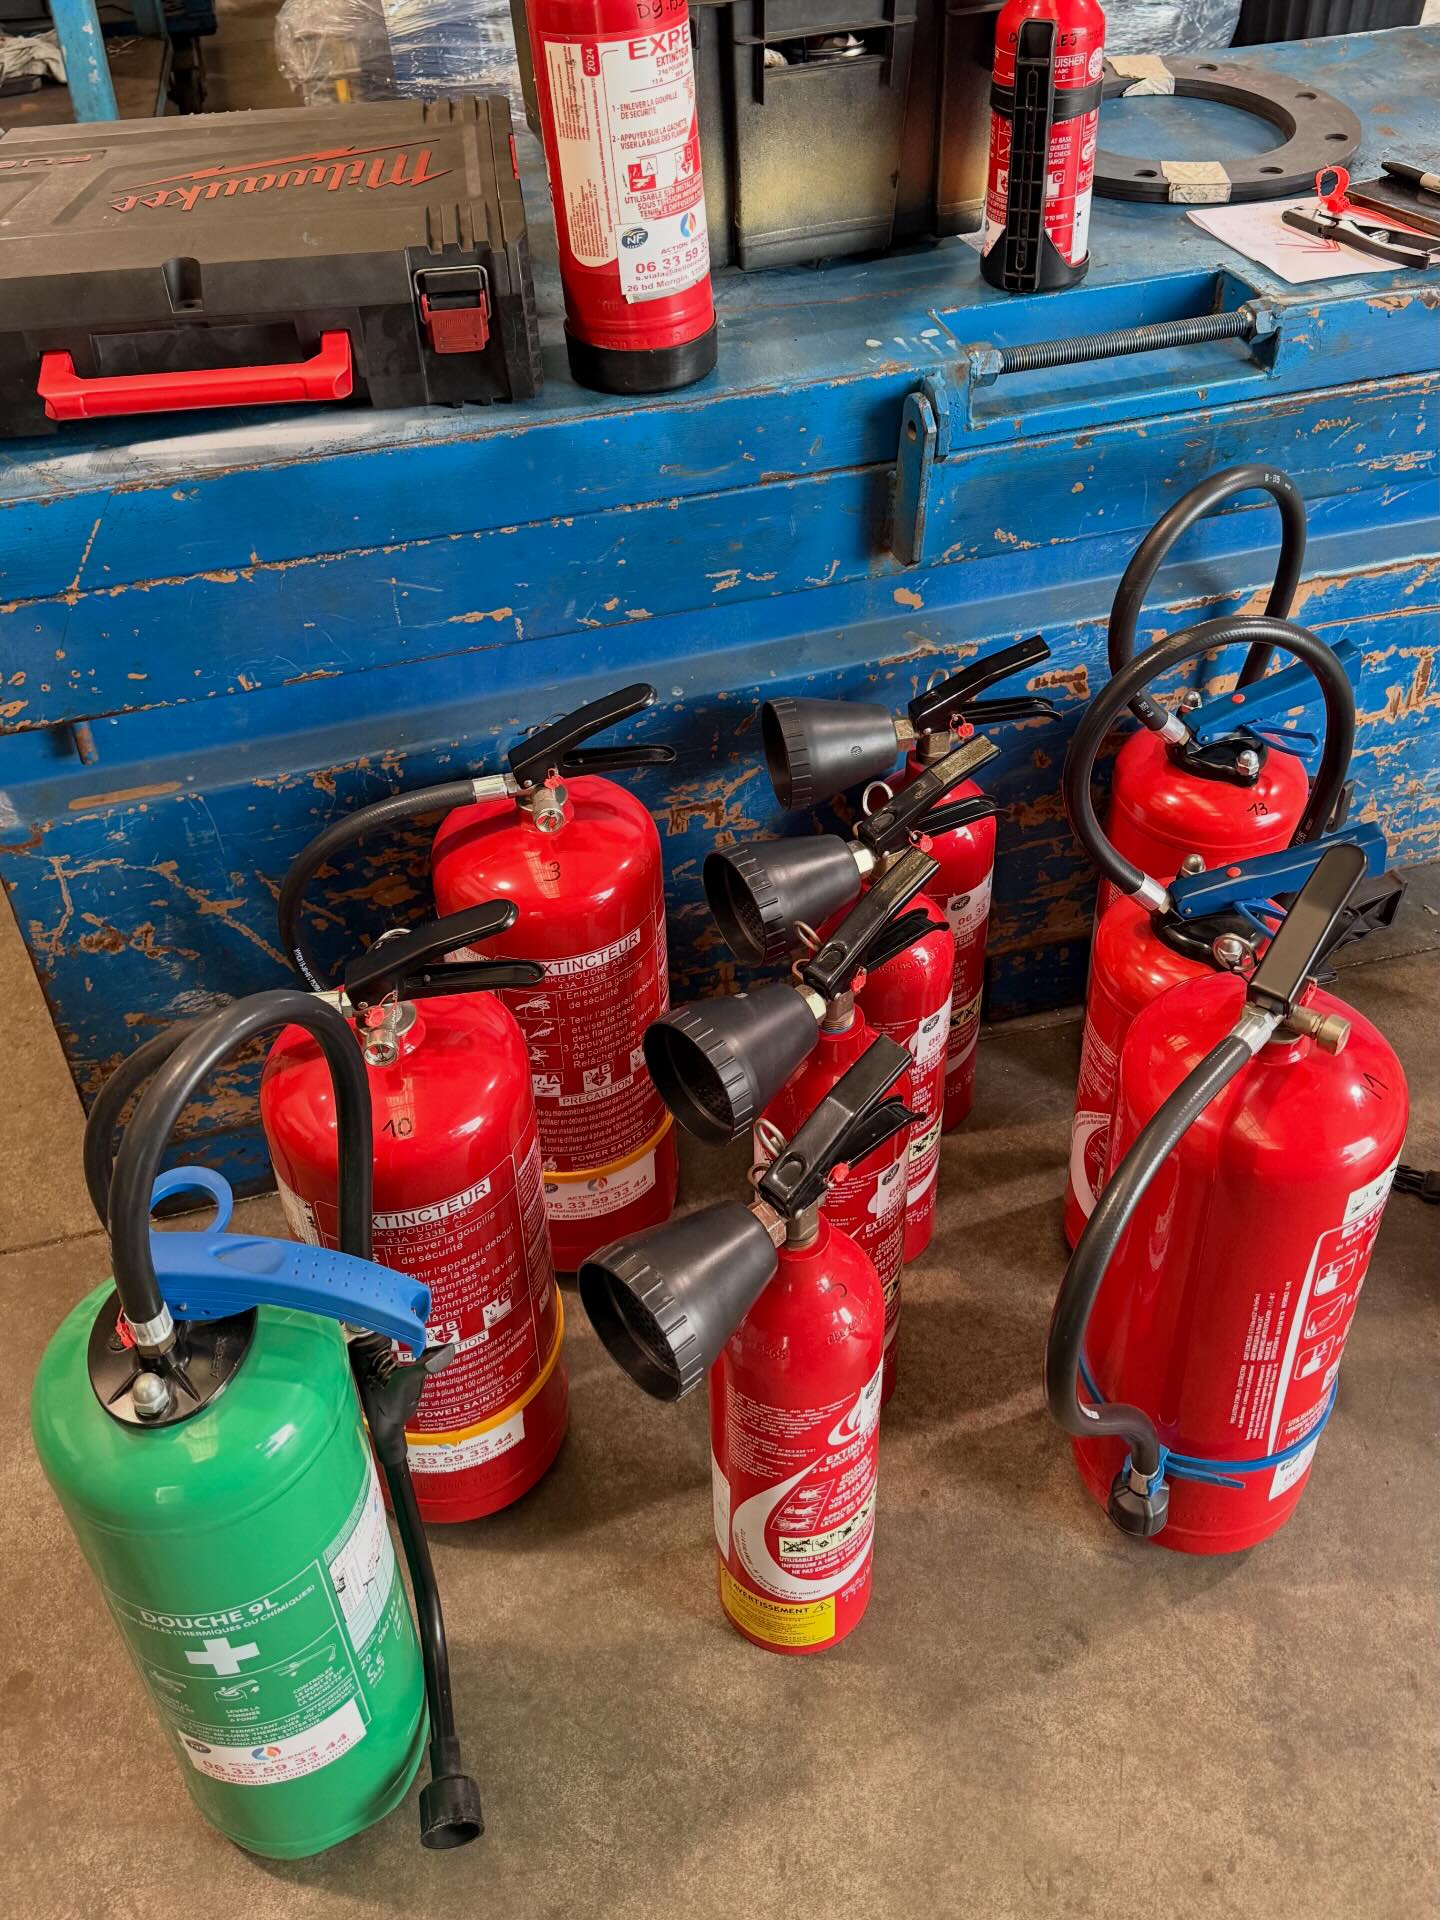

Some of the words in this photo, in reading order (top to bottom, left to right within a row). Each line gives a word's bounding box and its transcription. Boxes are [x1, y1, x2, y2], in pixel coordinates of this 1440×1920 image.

[587, 48, 598, 73] 2024
[620, 100, 646, 112] ENLEVER
[621, 111, 630, 119] DE
[620, 130, 648, 141] APPUYER
[620, 140, 638, 150] VISER
[645, 161, 654, 171] A
[109, 148, 454, 213] Milwaukee
[637, 200, 656, 210] SOUS
[626, 234, 645, 246] NF
[635, 261, 657, 274] 06
[662, 255, 681, 270] 33
[685, 247, 698, 262] 59
[627, 284, 639, 292] 26
[641, 282, 654, 291] bd
[1246, 802, 1269, 816] 13
[541, 860, 561, 882] 3
[544, 975, 566, 984] 9KG
[568, 962, 610, 981] POUDRE
[611, 953, 629, 967] ABC
[558, 981, 577, 990] 43A
[584, 973, 607, 986] 233B
[613, 966, 620, 974] C
[567, 985, 601, 1001] Enlever
[604, 981, 613, 989] la
[614, 961, 643, 988] goupille
[569, 999, 582, 1010] de
[583, 988, 619, 1007] sécurité
[570, 1012, 593, 1025] Tenir
[594, 994, 633, 1020] l'appareil
[571, 1025, 581, 1034] et
[583, 1019, 605, 1033] viser
[607, 1016, 616, 1024] la
[616, 1003, 636, 1020] base
[572, 1033, 589, 1043] des
[572, 1051, 586, 1060] de
[587, 1030, 638, 1057] commande.
[573, 1031, 613, 1053] Appuyer
[614, 1025, 629, 1037] sur
[630, 1019, 637, 1029] le
[573, 1052, 617, 1069] Relâcher
[618, 1037, 638, 1057] pour
[550, 1074, 561, 1083] A
[601, 1063, 611, 1073] B
[562, 1079, 632, 1106] PRECAUTION
[381, 1116, 413, 1139] 10
[570, 1149, 608, 1163] POWER
[610, 1132, 642, 1155] SAINTS
[568, 1201, 586, 1210] 33
[591, 1195, 609, 1206] 59
[613, 1187, 630, 1199] 33
[633, 1174, 648, 1189] 44
[387, 1236, 410, 1245] 43A
[417, 1228, 446, 1241] 233B
[454, 1220, 463, 1228] C
[398, 1219, 450, 1236] POUDRE
[452, 1206, 475, 1222] ABC
[398, 1240, 441, 1255] Enlever
[445, 1236, 455, 1245] la
[456, 1211, 497, 1240] goupille
[401, 1255, 416, 1265] de
[418, 1242, 464, 1262] sécurité
[433, 1247, 484, 1277] l'appareil
[484, 1223, 514, 1252] debout
[450, 1269, 461, 1280] la
[462, 1257, 487, 1278] base
[462, 1283, 479, 1294] sur
[480, 1276, 490, 1286] le
[491, 1251, 517, 1279] levier
[466, 1293, 490, 1311] pour
[492, 1266, 521, 1295] arrêter
[500, 1290, 511, 1300] C
[444, 1319, 458, 1330] B
[435, 1374, 468, 1389] électrique
[468, 1370, 483, 1382] sous
[446, 1357, 488, 1377] températures
[416, 1406, 461, 1418] POWER
[463, 1386, 504, 1409] SAINTS
[441, 1387, 455, 1400] plus
[464, 1379, 476, 1390] 100
[417, 1456, 438, 1466] 33
[444, 1454, 464, 1464] 59
[470, 1446, 490, 1458] 33
[494, 1431, 513, 1447] 44
[732, 1583, 810, 1615] AVERTISSEMENT
[140, 1609, 244, 1630] DOUCHE
[248, 1597, 280, 1616] 9L
[243, 1618, 259, 1629] OU
[202, 1760, 225, 1774] 06
[236, 1766, 257, 1776] 33
[262, 1763, 288, 1775] 59
[295, 1750, 319, 1768] 33
[325, 1732, 348, 1752] 44
